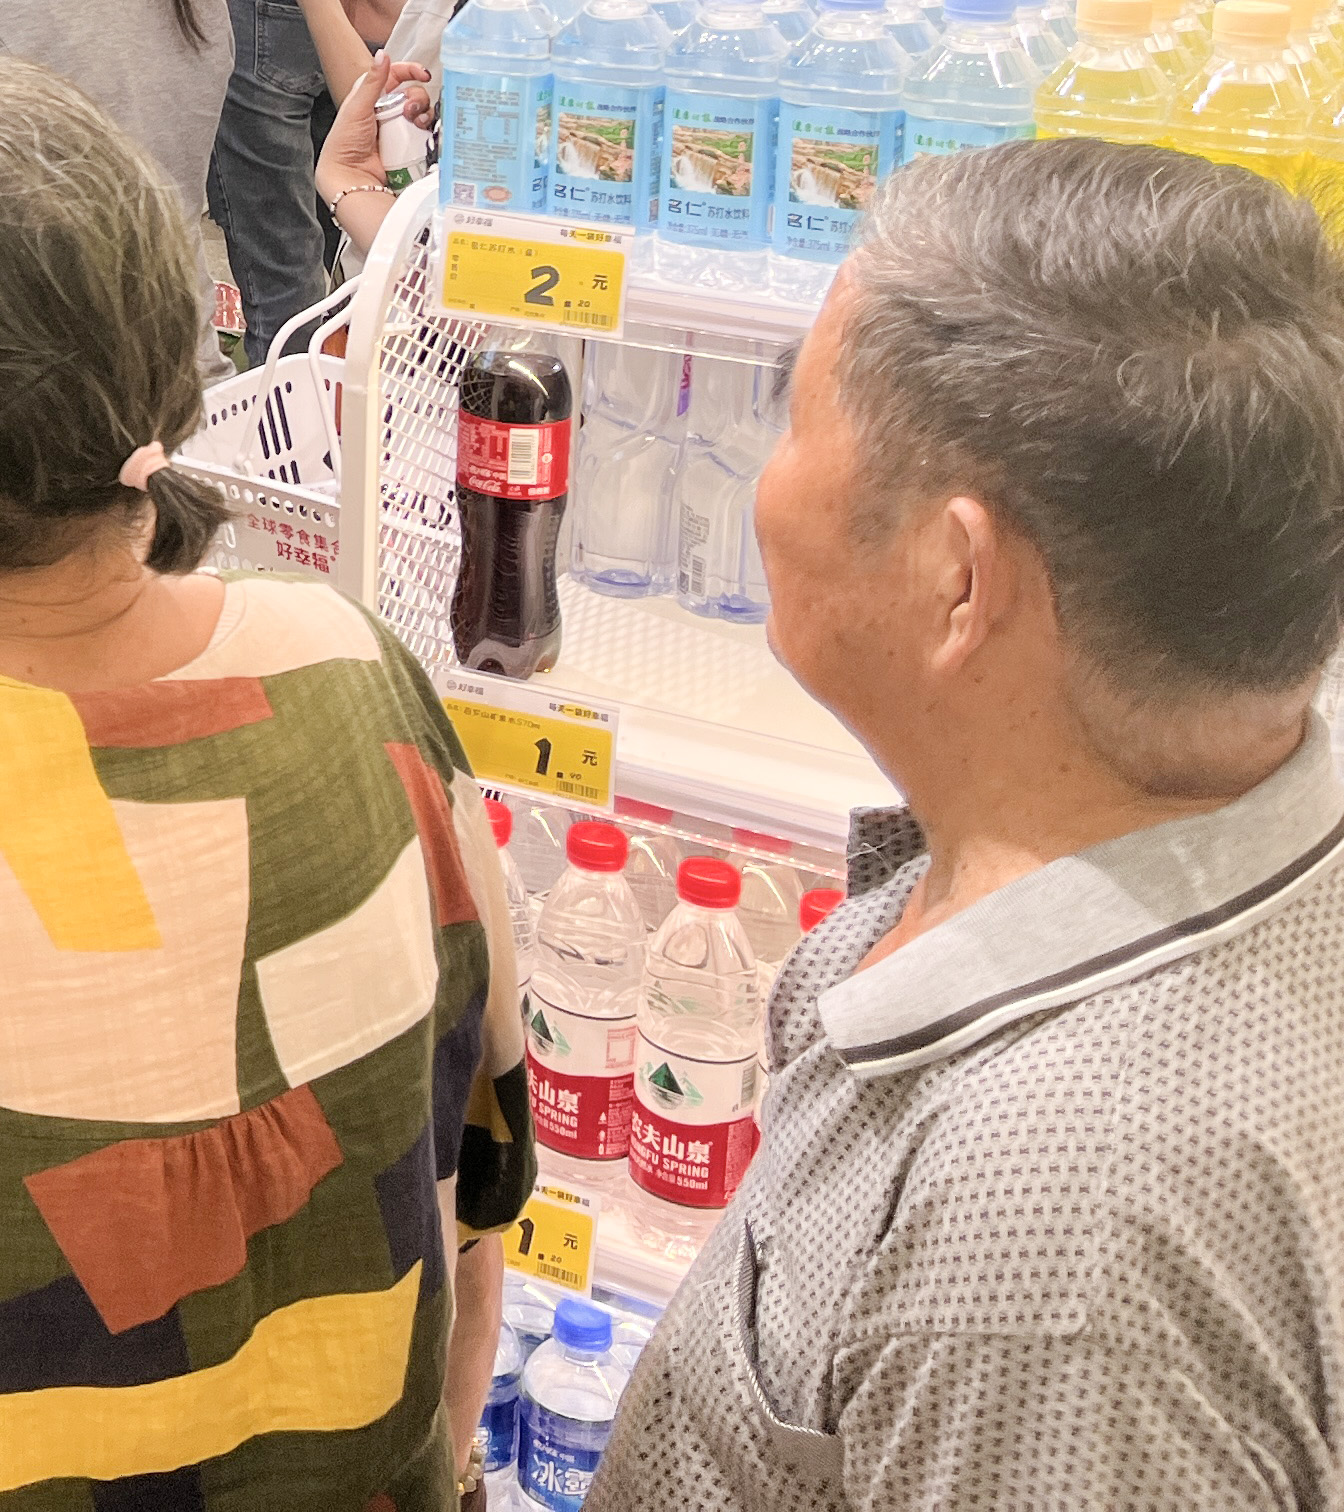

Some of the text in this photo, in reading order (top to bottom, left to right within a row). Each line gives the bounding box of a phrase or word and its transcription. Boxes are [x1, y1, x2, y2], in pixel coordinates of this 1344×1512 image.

[553, 183, 586, 202] 名仁
[668, 198, 703, 217] 名仁
[787, 212, 825, 232] 名仁
[524, 265, 608, 307] 2 元
[276, 539, 330, 574] 好幸福
[534, 737, 598, 776] 1 元
[538, 1103, 578, 1128] SPRING
[662, 1157, 709, 1179] SPRING
[676, 1174, 709, 1191] 550ml
[518, 1217, 578, 1256] 1 元
